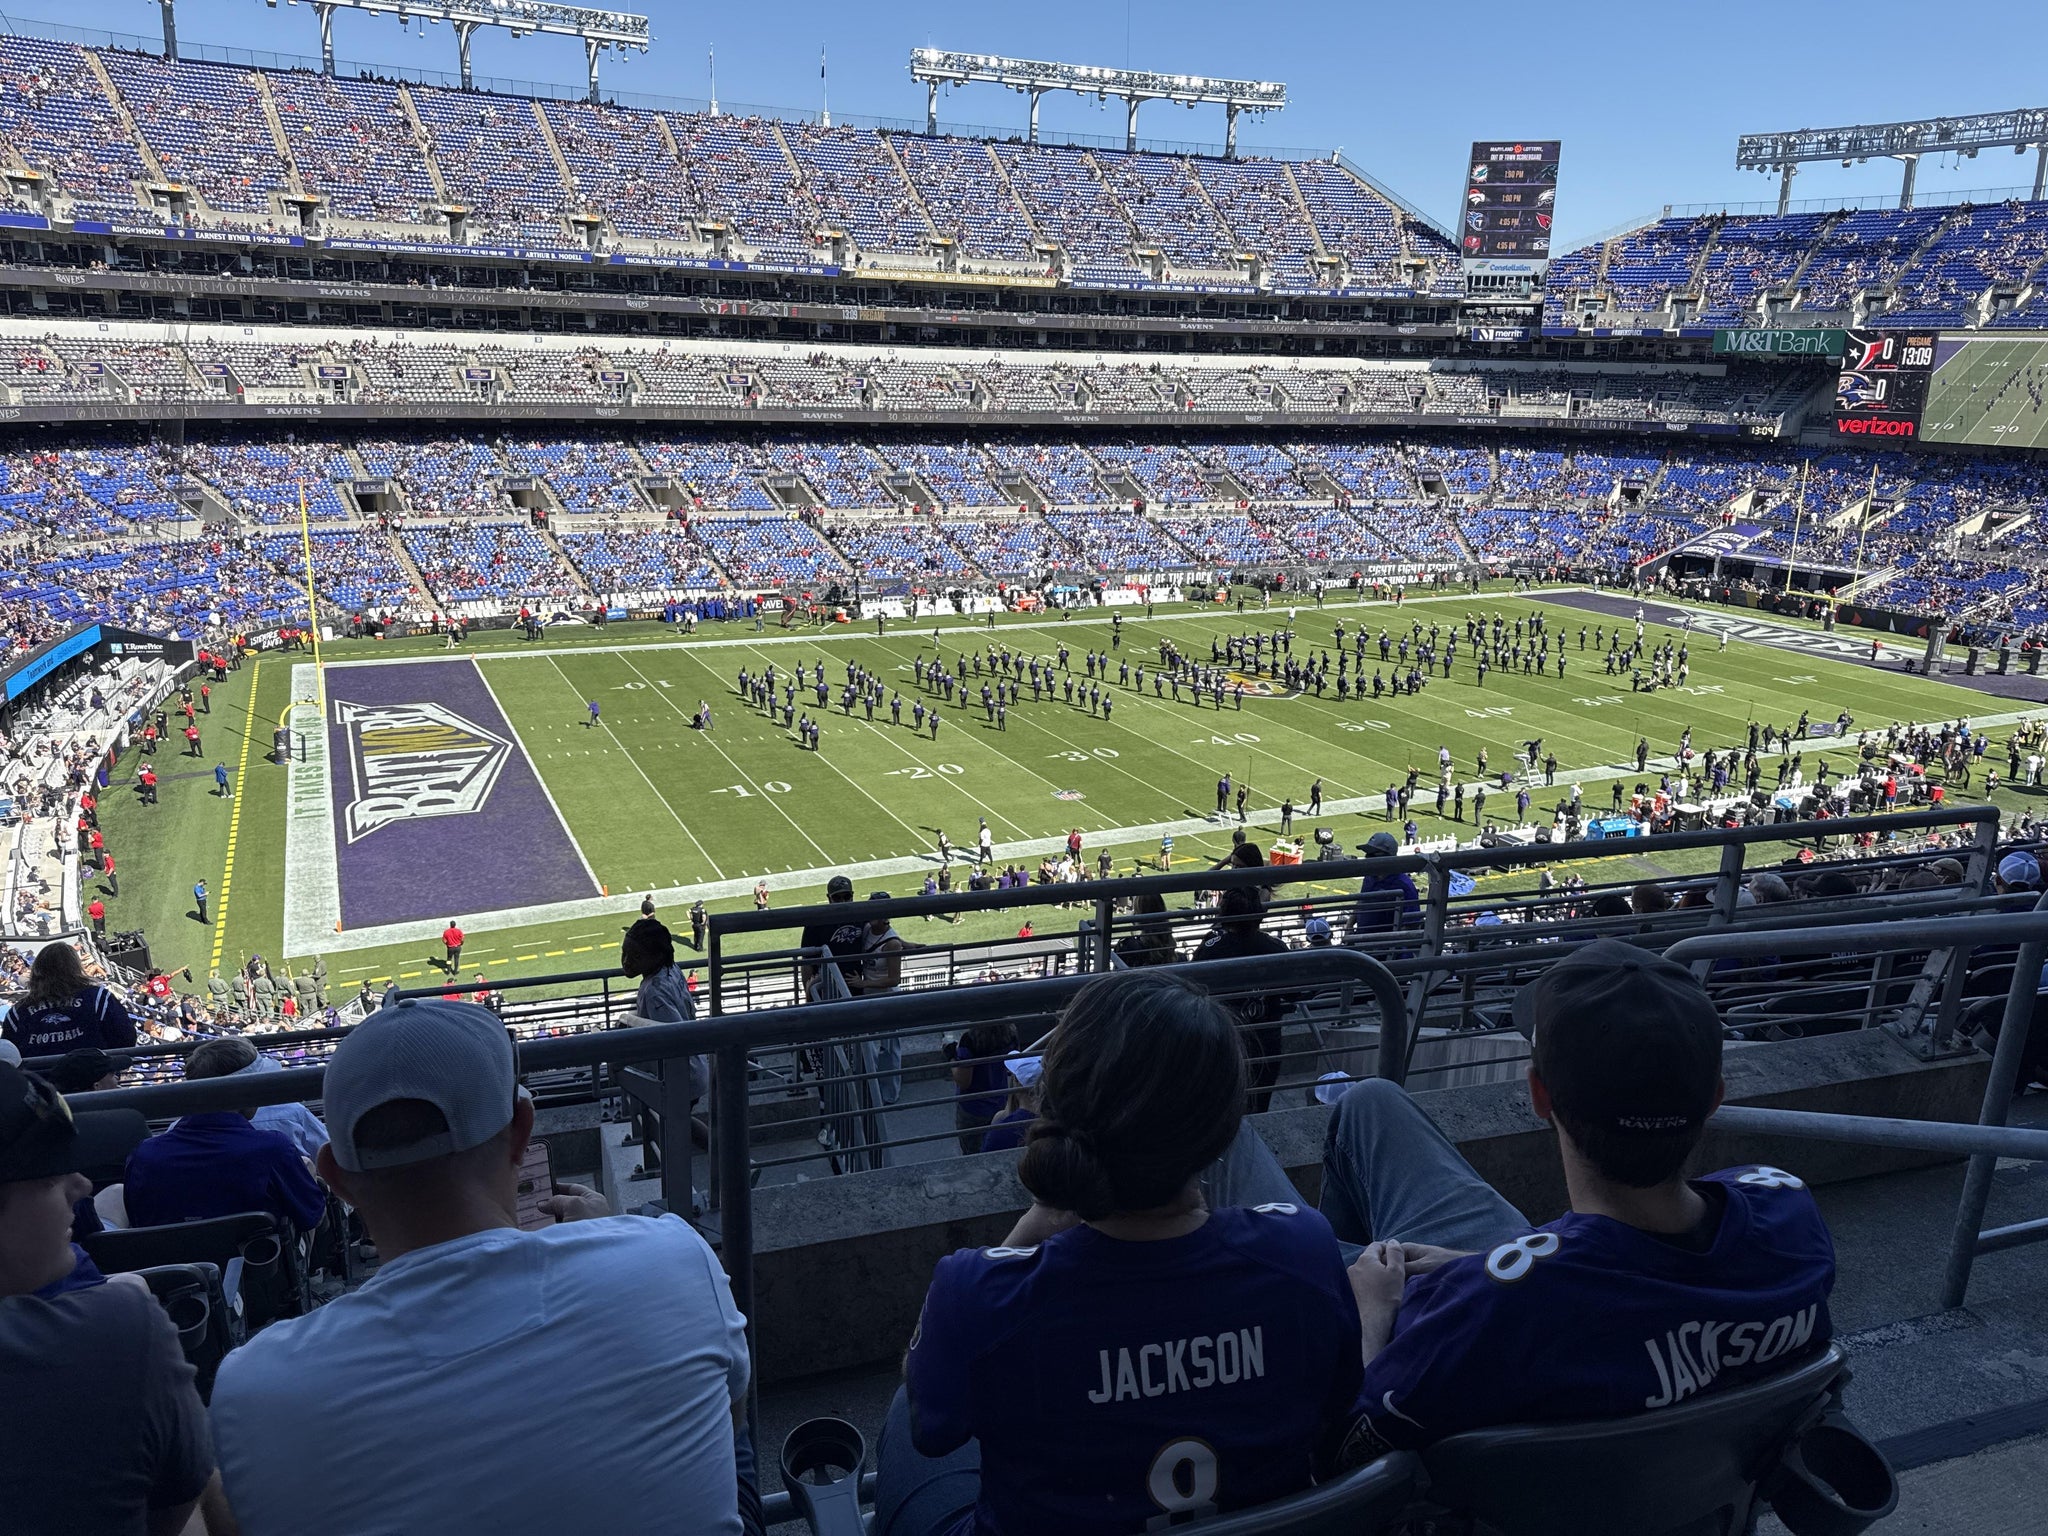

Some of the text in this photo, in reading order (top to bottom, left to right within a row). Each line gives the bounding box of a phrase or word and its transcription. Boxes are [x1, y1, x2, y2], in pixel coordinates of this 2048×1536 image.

[112, 226, 166, 236] RING HONOR
[196, 232, 290, 244] EARNEST BYNER 1996-2003
[388, 244, 416, 252] BALTIMORE
[626, 257, 708, 268] MICHAEL McCRARY 1997-2002
[796, 266, 824, 274] 1997-2005
[862, 270, 888, 278] JONATHAN
[908, 273, 936, 281] 1996-2007
[54, 274, 86, 285] RAVENS
[318, 288, 371, 298] RAVENS
[445, 294, 495, 303] SEASONS
[627, 300, 648, 308] RAVENS
[732, 304, 737, 314] 0
[784, 306, 788, 316] 0
[842, 310, 886, 320] 13:09 PREGAME
[1017, 317, 1036, 326] RAVENS
[1724, 331, 1831, 352] M&T Bank
[1907, 337, 1932, 346] PREGAME
[1882, 338, 1894, 360] 0
[1902, 347, 1932, 365] 13:09
[1875, 379, 1886, 400] 0
[66, 408, 202, 418] FOREVERMORE
[400, 408, 455, 416] SEASONS
[485, 408, 546, 416] 1996 2025
[595, 408, 620, 416] RAVENS
[888, 413, 943, 421] 30 SEASONS
[1666, 423, 1688, 431] RAVENS
[1752, 426, 1773, 435] 13:09
[1838, 417, 1914, 436] verizon
[1155, 573, 1166, 585] OF
[1187, 571, 1212, 584] FLOCK
[1668, 611, 1902, 662] RAVENS
[296, 717, 321, 728] US
[1334, 719, 1392, 732] 50
[1208, 732, 1261, 747] 40
[1060, 747, 1119, 762] 30
[337, 701, 512, 838] BALTIMORE
[901, 763, 965, 779] 20
[295, 766, 325, 803] TAKES
[728, 781, 792, 798] 10
[294, 808, 326, 819] IT
[153, 984, 164, 992] 99
[27, 998, 83, 1016] RAVENS
[28, 1026, 84, 1045] FOOTBALL
[1618, 1118, 1688, 1130] RAVENS
[1736, 1166, 1804, 1190] 8
[1484, 1232, 1562, 1283] 8
[1645, 1304, 1818, 1409] JACKSON
[1088, 1326, 1264, 1404] JACKSON
